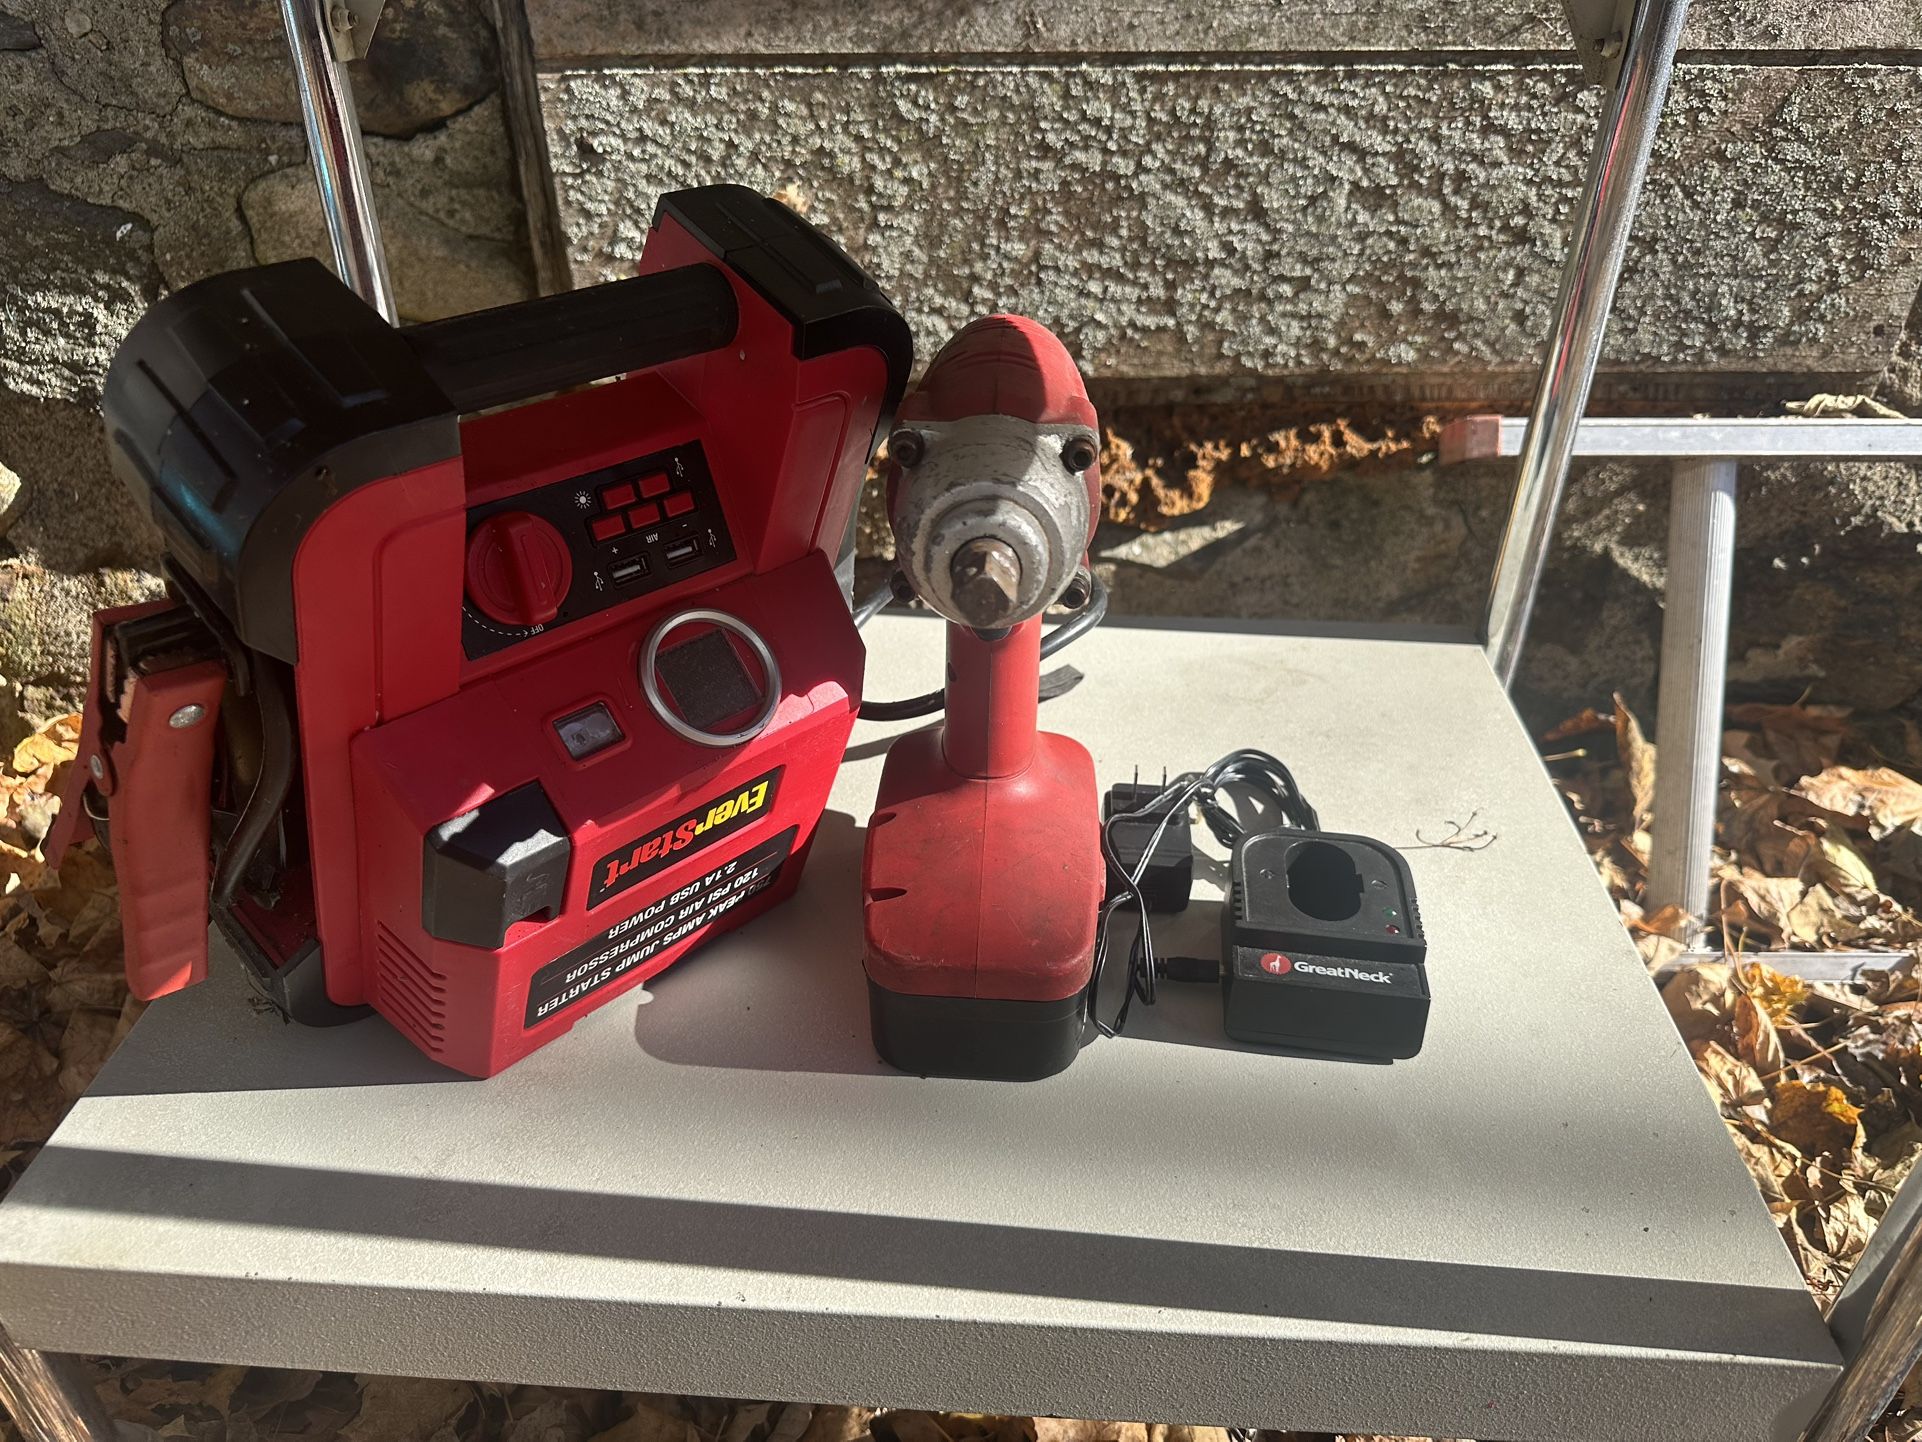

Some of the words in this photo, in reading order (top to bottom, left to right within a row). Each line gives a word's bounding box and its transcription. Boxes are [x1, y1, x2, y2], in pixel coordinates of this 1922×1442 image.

[645, 532, 659, 543] AIR
[530, 623, 545, 636] OFF
[603, 780, 769, 888] EverStart
[705, 860, 738, 887] 2.1A
[733, 867, 759, 890] 120
[669, 880, 700, 905] USB
[707, 883, 731, 905] PSI
[710, 889, 746, 920] PEAK
[608, 899, 666, 939] POWER
[678, 896, 707, 920] AIR
[662, 912, 709, 946] AMPS
[565, 915, 675, 984] COMPRESSOR
[615, 940, 660, 973] JUMP
[1293, 961, 1392, 984] GreatNeck
[537, 968, 612, 1017] STARTER
